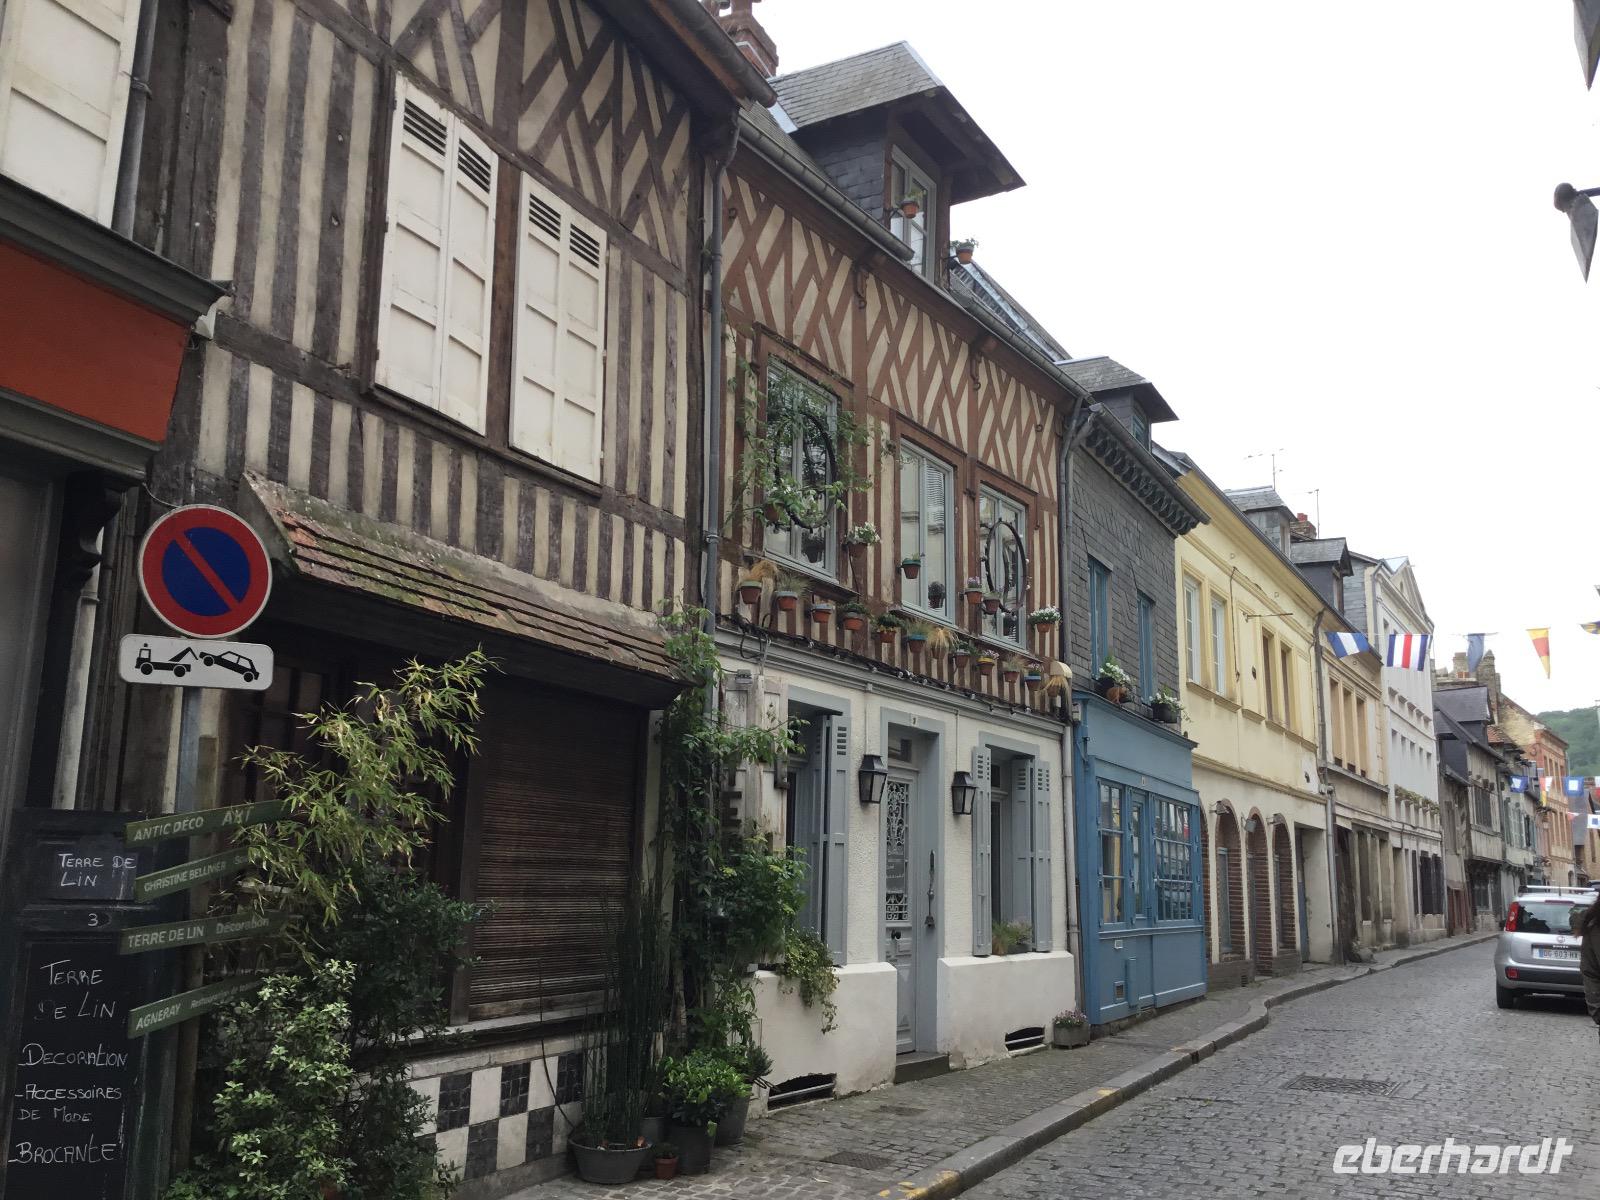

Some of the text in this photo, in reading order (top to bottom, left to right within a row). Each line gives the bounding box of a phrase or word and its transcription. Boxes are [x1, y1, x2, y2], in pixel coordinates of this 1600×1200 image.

[133, 823, 172, 842] ANTIC
[57, 853, 137, 869] TERRE DE
[144, 869, 188, 893] CHRISTINE
[87, 912, 99, 927] 3
[128, 931, 166, 949] TERRE
[168, 927, 185, 944] DE
[186, 924, 205, 942] LIN
[40, 959, 103, 986] TERRE
[135, 1003, 183, 1031] AGNERAY
[17, 1105, 94, 1123] DE MODE
